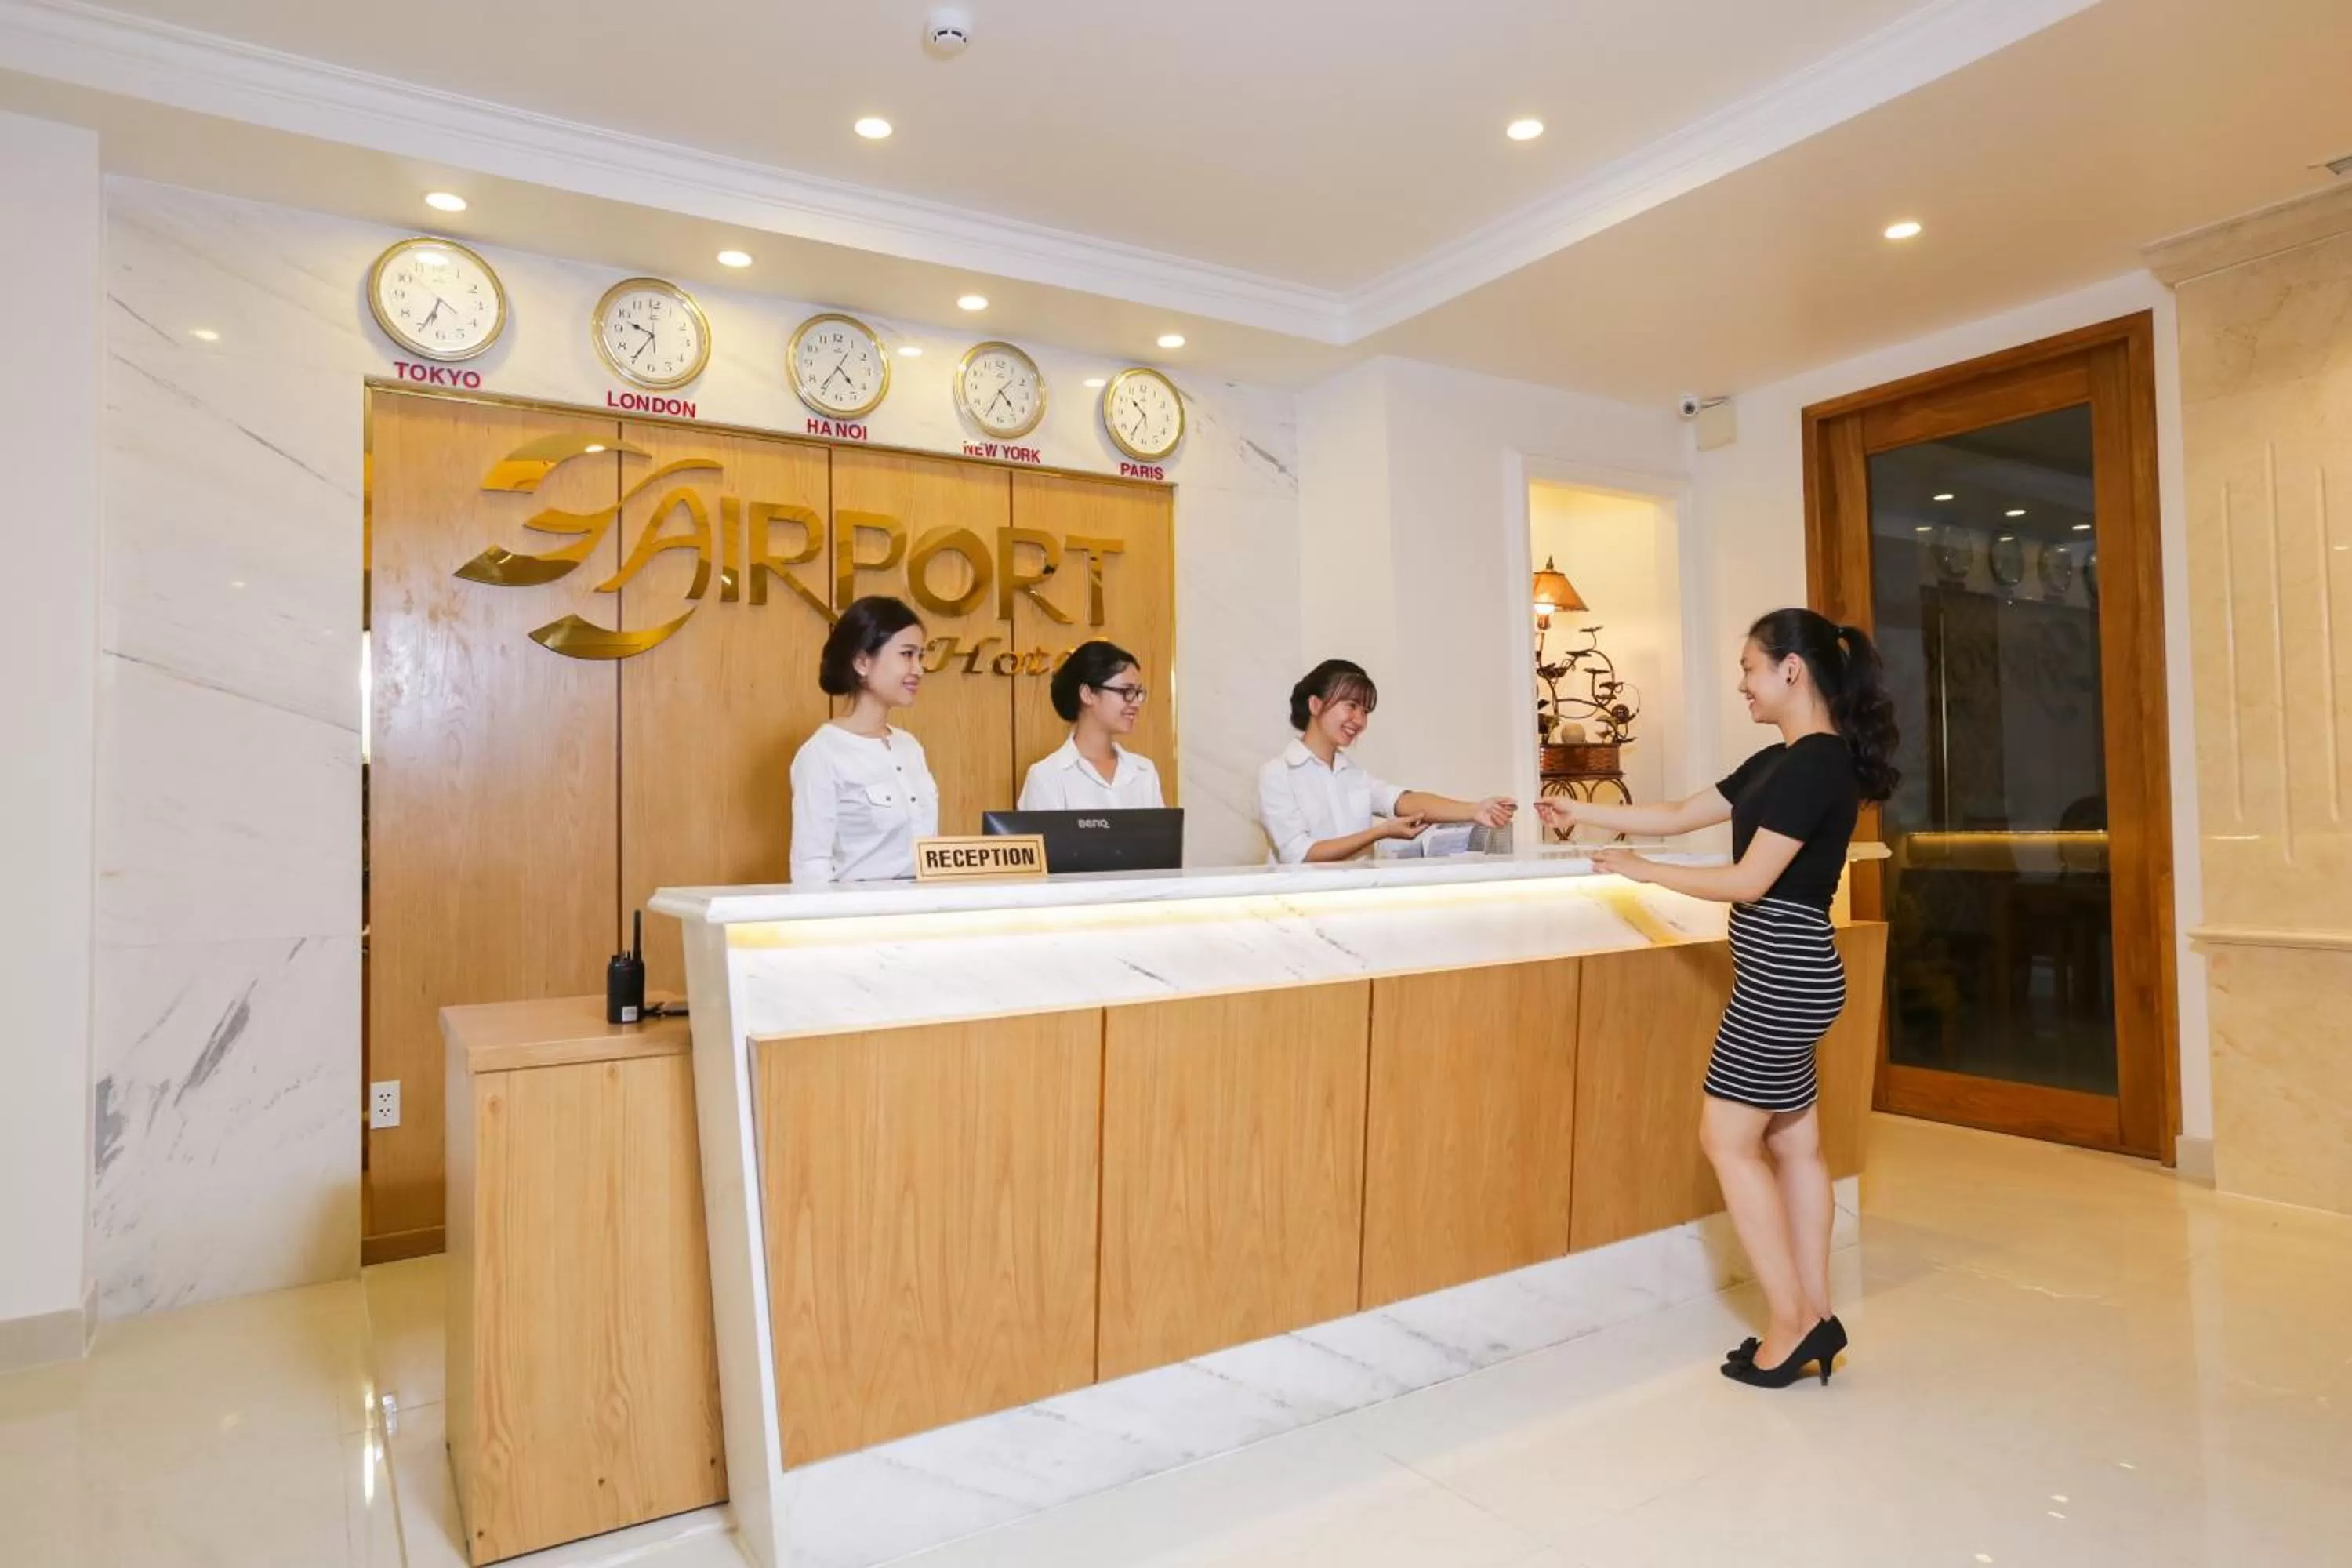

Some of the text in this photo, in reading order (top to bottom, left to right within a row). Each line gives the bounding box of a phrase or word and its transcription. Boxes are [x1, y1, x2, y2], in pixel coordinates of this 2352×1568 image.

[394, 361, 481, 388] TOKYO
[607, 390, 696, 418] LONDON
[963, 440, 1040, 463] NEW YORK
[1120, 462, 1164, 481] PARIS
[593, 459, 1124, 626] AIRPORT
[925, 848, 1035, 869] RECEPTION
